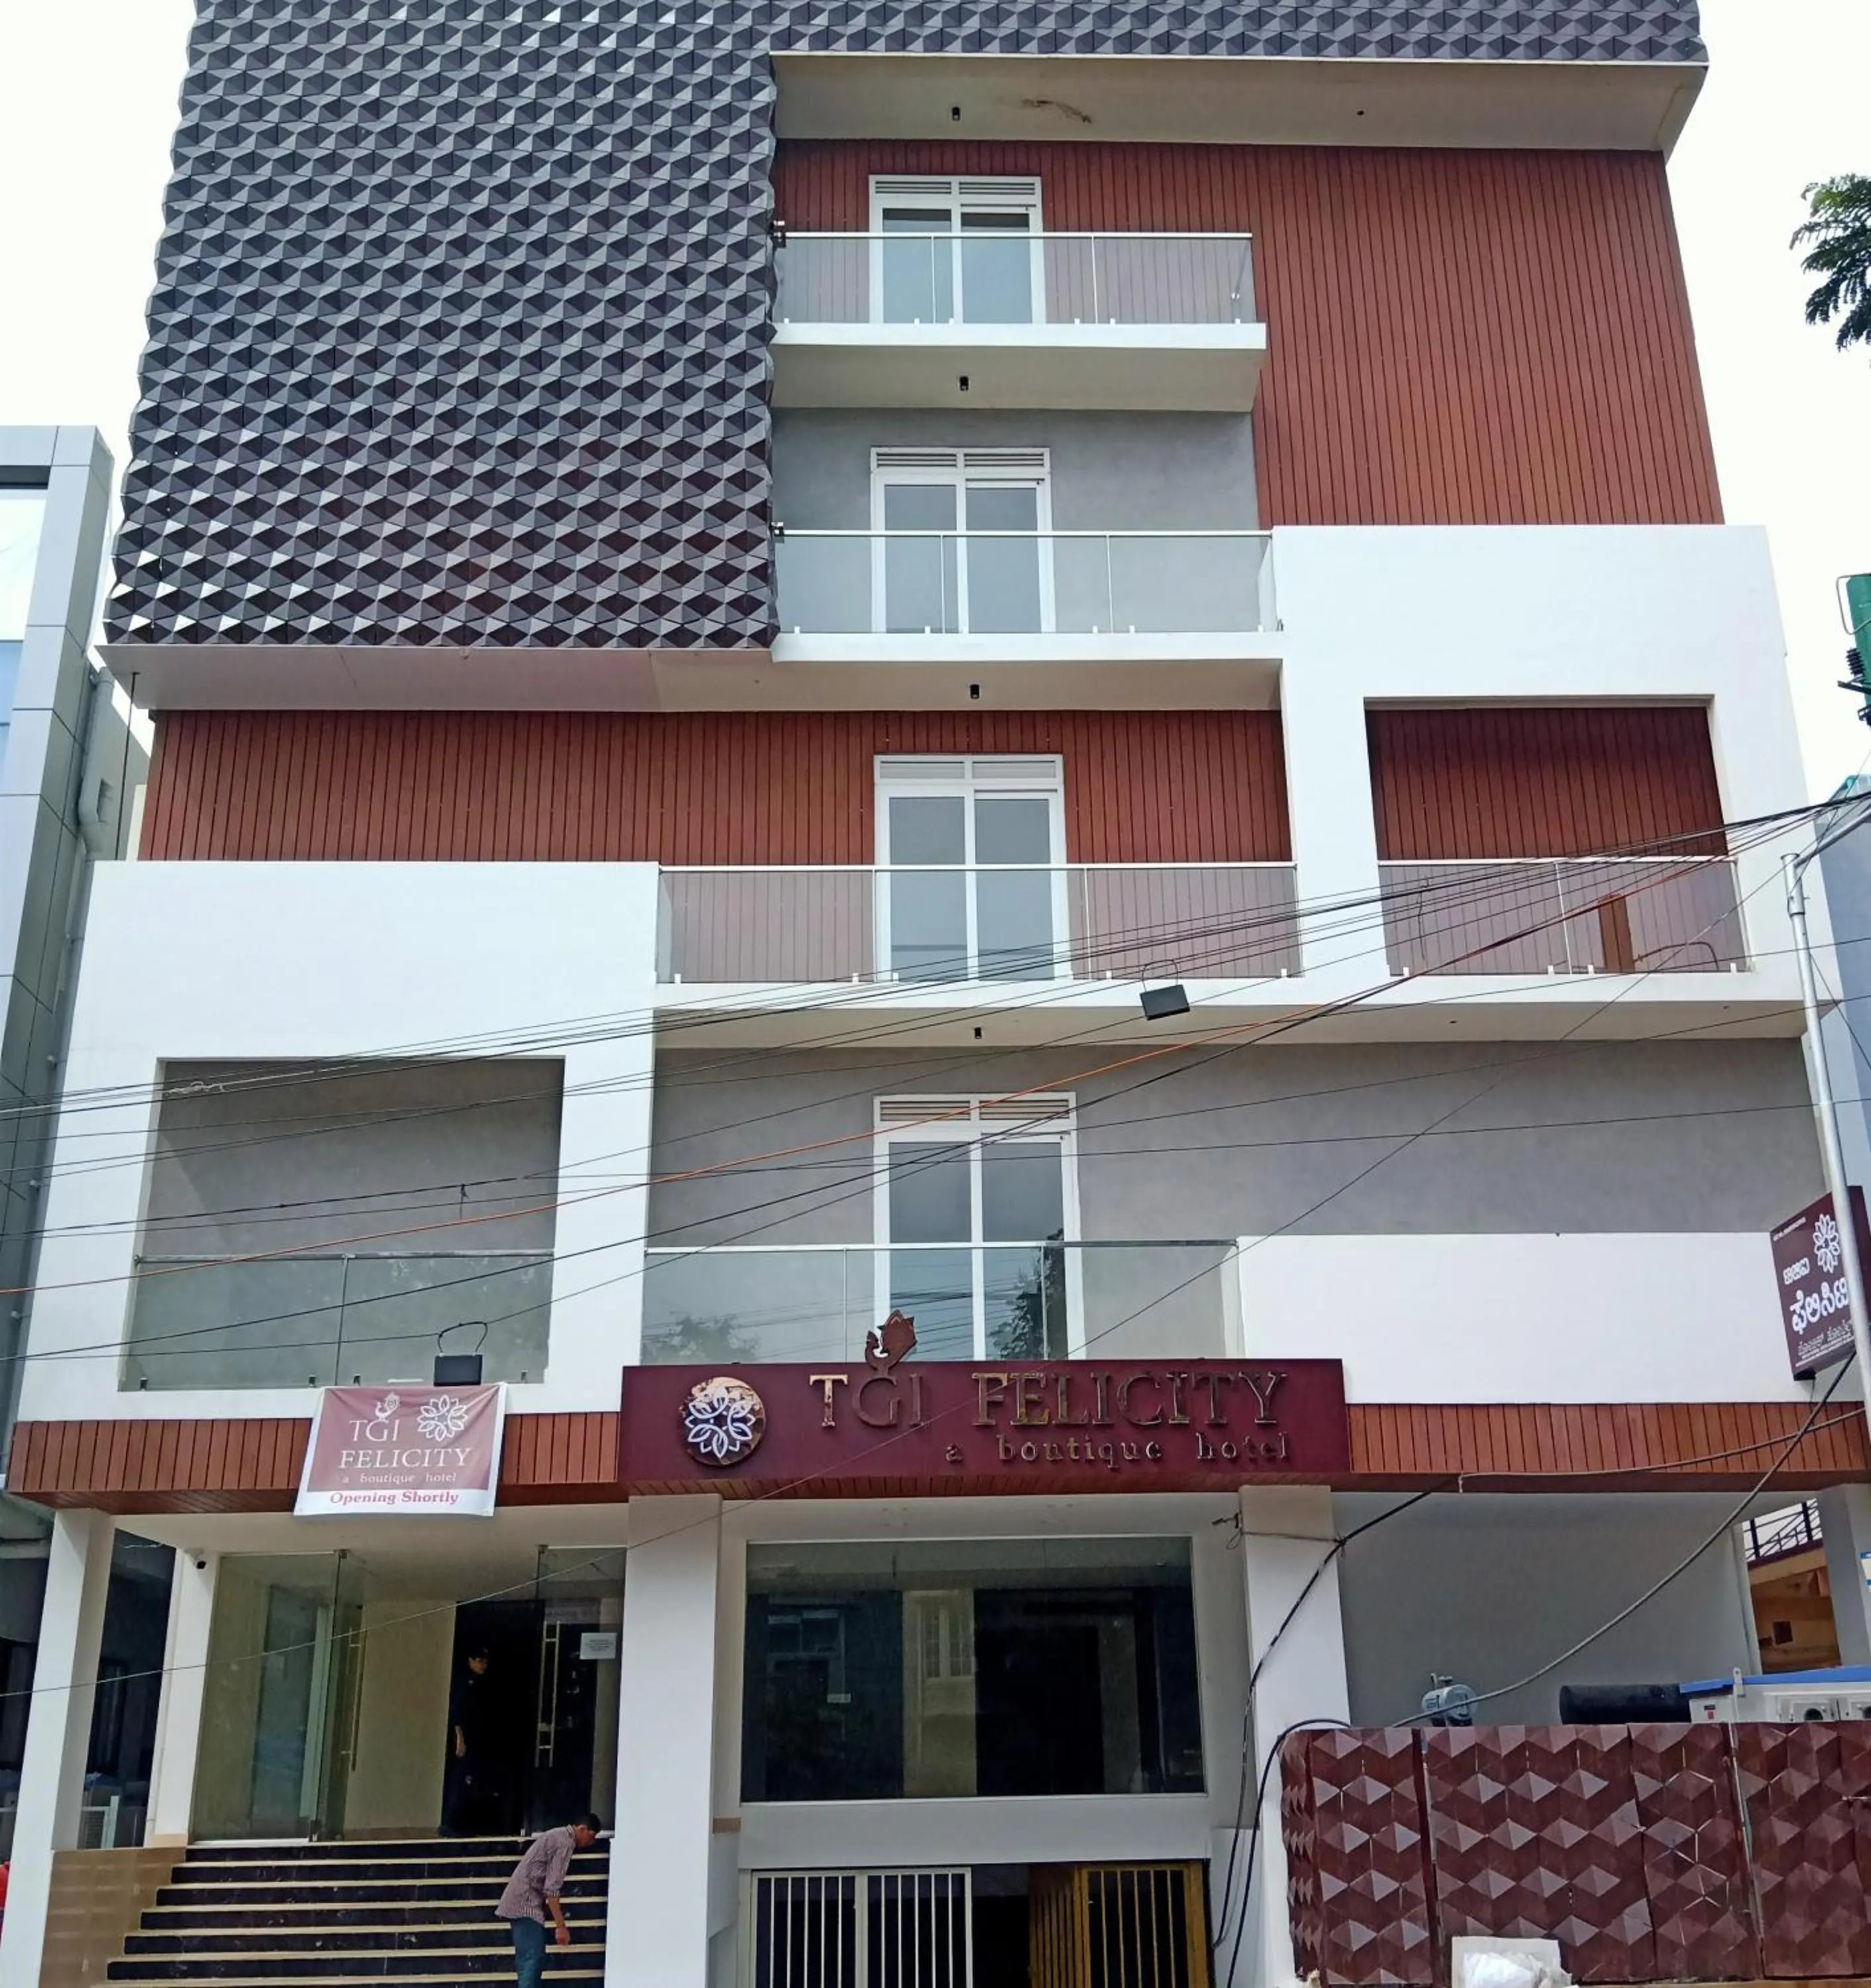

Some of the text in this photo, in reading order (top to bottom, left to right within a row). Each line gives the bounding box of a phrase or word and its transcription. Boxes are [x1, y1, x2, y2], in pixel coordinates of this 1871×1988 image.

[808, 1371, 1288, 1428] TGI FELICITY
[348, 1419, 400, 1442] TGI
[338, 1447, 472, 1469] FELICITY
[945, 1432, 1289, 1469] a boutique hotel
[360, 1472, 416, 1485] boutique
[425, 1472, 457, 1483] hotel
[330, 1488, 459, 1506] Opening Shortly
